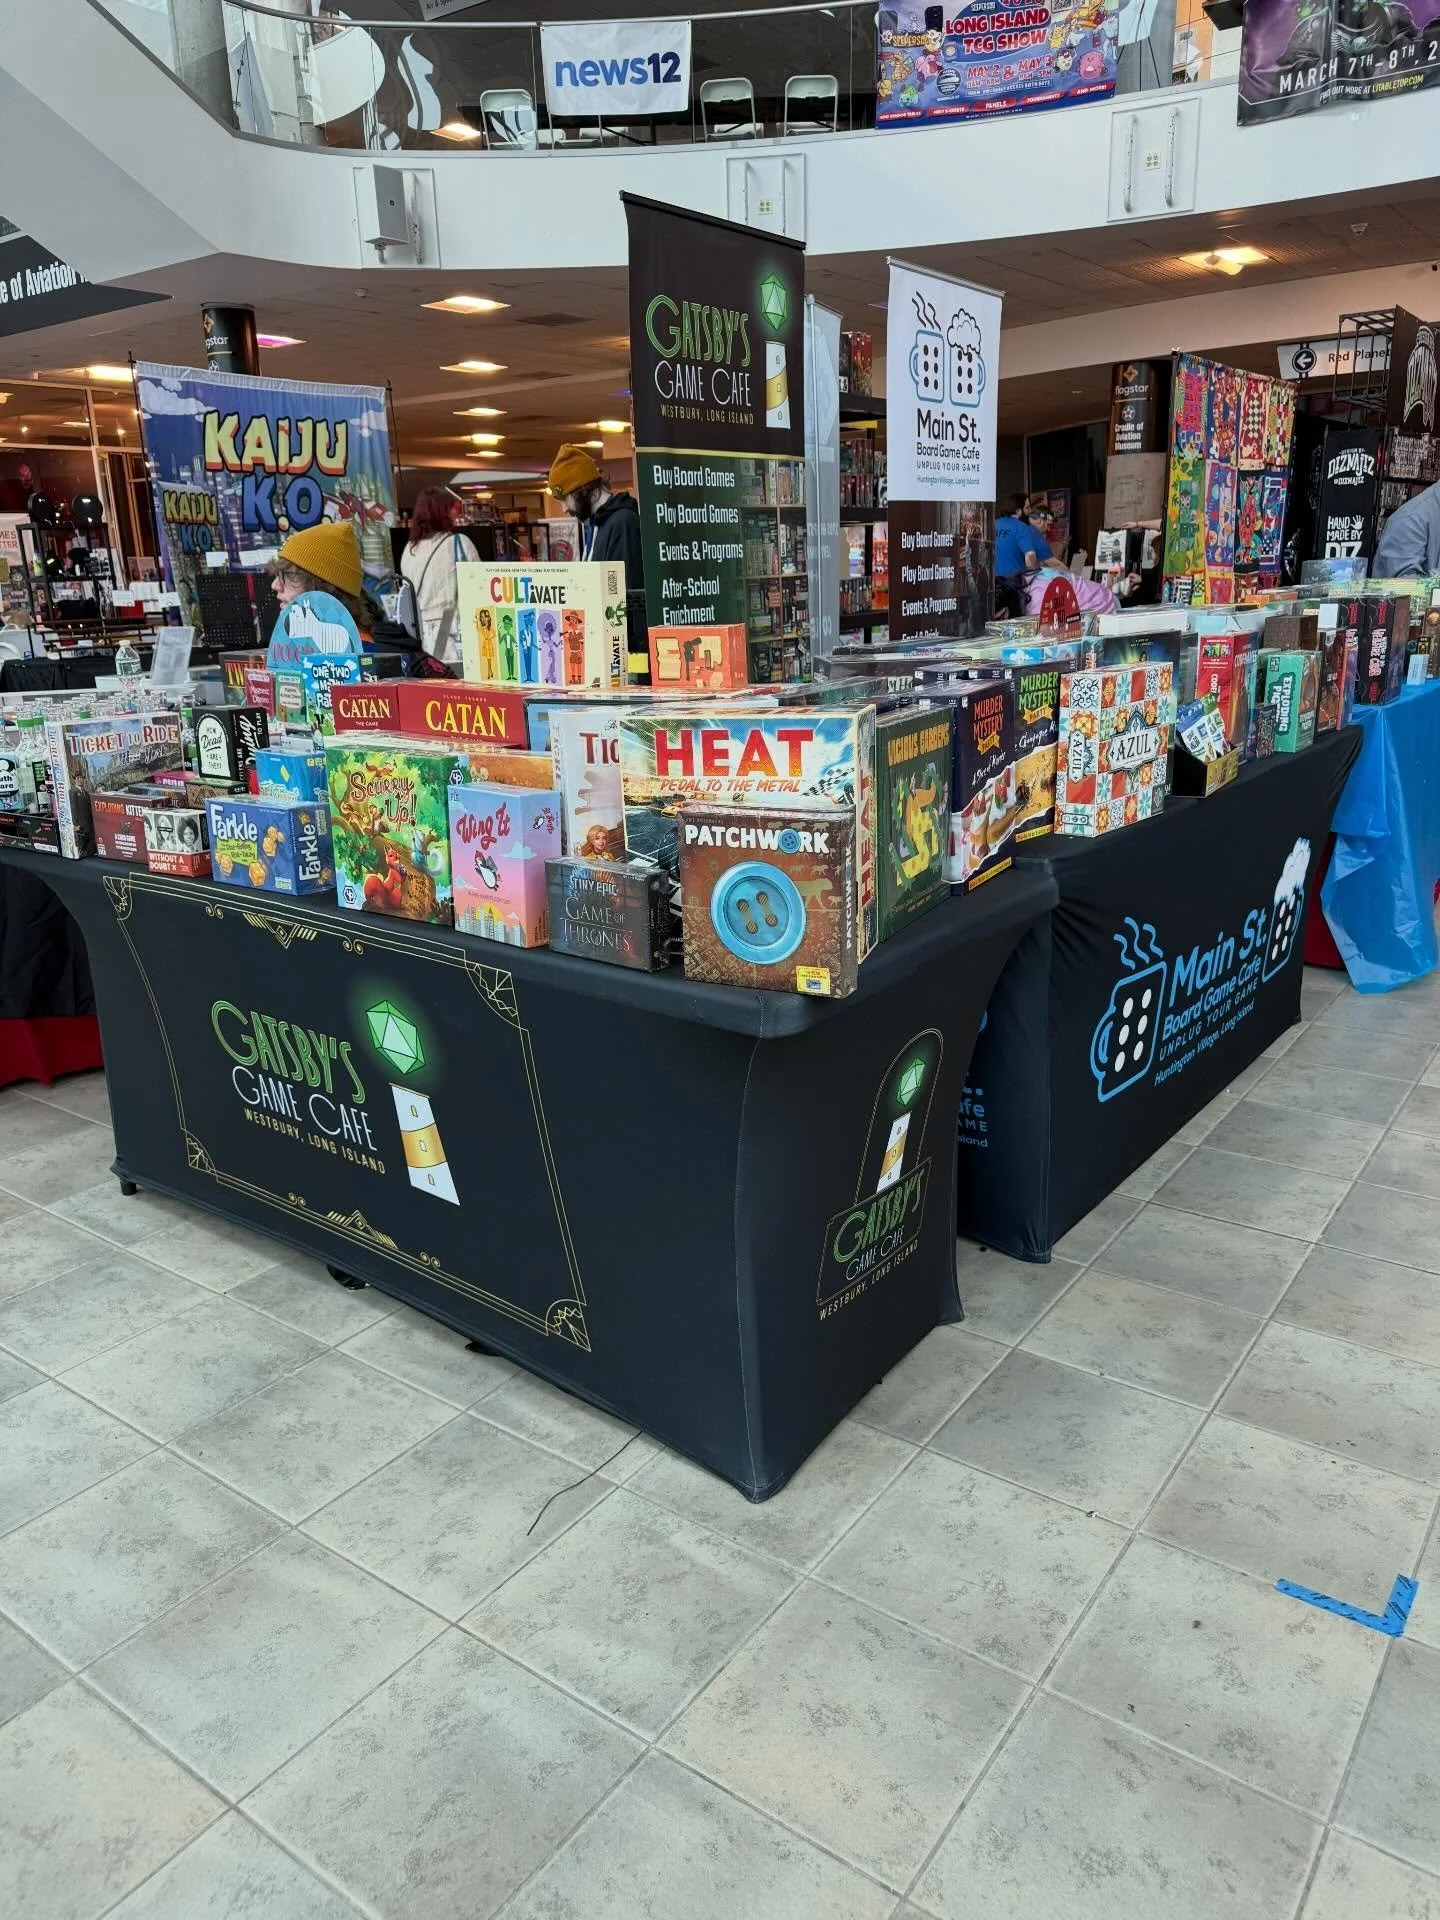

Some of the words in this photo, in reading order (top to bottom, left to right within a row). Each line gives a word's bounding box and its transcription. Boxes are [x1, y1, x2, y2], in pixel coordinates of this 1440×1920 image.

[945, 15, 988, 35] LONG
[990, 8, 1050, 31] ISLAND
[963, 35, 994, 54] TCG
[996, 28, 1048, 51] SHOW
[555, 51, 682, 87] news12
[968, 65, 990, 79] MAY
[992, 64, 1000, 75] 2
[1003, 65, 1015, 81] &
[1018, 57, 1041, 72] MAY
[1045, 55, 1053, 67] 3
[1279, 57, 1338, 93] MARCH
[1332, 85, 1344, 96] OUT
[1345, 84, 1362, 95] MORE
[1363, 84, 1371, 95] AT
[1372, 74, 1424, 93] LITABLETOP.COM
[10, 272, 23, 302] of
[26, 261, 77, 297] Aviation
[645, 294, 751, 367] GATSBY'S
[1328, 351, 1350, 363] Red
[655, 360, 705, 402] GAME
[711, 368, 752, 407] CAFE
[660, 404, 703, 422] WESTBURY,
[706, 409, 726, 423] LONG
[728, 412, 754, 425] ISLAND
[917, 407, 955, 442] Main
[958, 413, 981, 443] St.
[1114, 421, 1135, 433] Cradle
[1136, 422, 1144, 431] of
[202, 410, 348, 476] KAIJU
[916, 441, 939, 458] Board
[939, 444, 961, 459] Game
[961, 446, 980, 460] Cafe
[653, 464, 673, 489] Buy
[674, 466, 704, 487] Board
[705, 467, 735, 488] Games
[916, 460, 941, 470] UNPLUG
[942, 462, 960, 472] YOUR
[962, 464, 980, 473] GAME
[163, 489, 218, 525] KAIJU
[242, 474, 333, 532] K.O.
[656, 503, 677, 528] Play
[678, 503, 708, 524] Board
[709, 504, 739, 524] Games
[1326, 529, 1350, 541] MADE
[1350, 529, 1363, 541] BY
[1327, 515, 1350, 530] HAND
[659, 541, 690, 562] Events
[692, 541, 702, 561] &
[702, 540, 744, 563] Programs
[901, 532, 915, 552] Buy
[916, 530, 933, 548] Board
[933, 531, 954, 548] Games
[1324, 541, 1363, 560] DIZ
[661, 576, 721, 600] After-School
[901, 565, 916, 585] Play
[917, 563, 934, 581] Board
[934, 564, 955, 581] Games
[662, 604, 716, 626] Enrichment
[902, 600, 923, 617] Events
[923, 598, 929, 613] &
[929, 597, 957, 615] Programs
[312, 665, 330, 679] ONE
[330, 663, 351, 679] TWO
[1020, 671, 1060, 693] MURDER
[339, 698, 391, 719] CATAN
[974, 694, 1004, 721] MURDER
[1018, 688, 1060, 711] MYSTERY
[1278, 675, 1293, 733] EXPLODING
[425, 700, 508, 739] CATAN
[973, 713, 1005, 741] MYSTERY
[66, 730, 125, 756] TICKET
[128, 731, 141, 746] TO
[142, 724, 181, 746] RIDE
[200, 731, 223, 750] Dead
[653, 728, 815, 777] HEAT
[887, 732, 919, 768] VICIOUS
[920, 721, 951, 750] GARDENS
[1115, 732, 1151, 762] AZUL
[1072, 739, 1083, 776] AZUL
[350, 771, 416, 803] Scurry
[659, 777, 704, 793] PEDAL
[705, 779, 723, 792] TO
[727, 779, 753, 792] THE
[755, 779, 803, 793] METAL
[94, 800, 125, 815] EXPLODING
[384, 792, 417, 832] Up!
[210, 804, 258, 842] Farkle
[456, 812, 498, 850] Wing
[495, 801, 511, 837] It
[298, 824, 321, 881] Farkle
[860, 769, 873, 908] HEAT
[149, 852, 177, 864] WITHOUT
[178, 855, 185, 864] A
[149, 860, 171, 870] DOUBT
[572, 878, 595, 891] TINY
[565, 896, 613, 924] GAME
[613, 912, 625, 924] OF
[560, 917, 633, 952] THRONES
[1168, 931, 1236, 1008] Main
[1239, 906, 1268, 961] St.
[1162, 993, 1204, 1042] Board
[1203, 976, 1237, 1012] Game
[1237, 954, 1262, 986] Cafe
[1159, 1020, 1203, 1062] UNPLUG
[1206, 999, 1232, 1027] YOUR
[1234, 977, 1259, 1005] GAME
[211, 1000, 366, 1104] GATSBY'S
[1154, 1049, 1196, 1088] Huntington
[1220, 1016, 1237, 1035] Long
[232, 1065, 303, 1122] GAME
[308, 1093, 378, 1151] CAFE
[243, 1107, 305, 1143] WESTBURY,
[308, 1132, 337, 1154] LONG
[341, 1145, 386, 1175] ISLAND
[833, 1168, 925, 1264] GATSBY'S
[845, 1244, 879, 1281] GAME
[880, 1224, 905, 1257] CAFE
[819, 1279, 869, 1321] WESTBURY,
[871, 1262, 891, 1284] LONG
[893, 1239, 919, 1270] ISLAND
